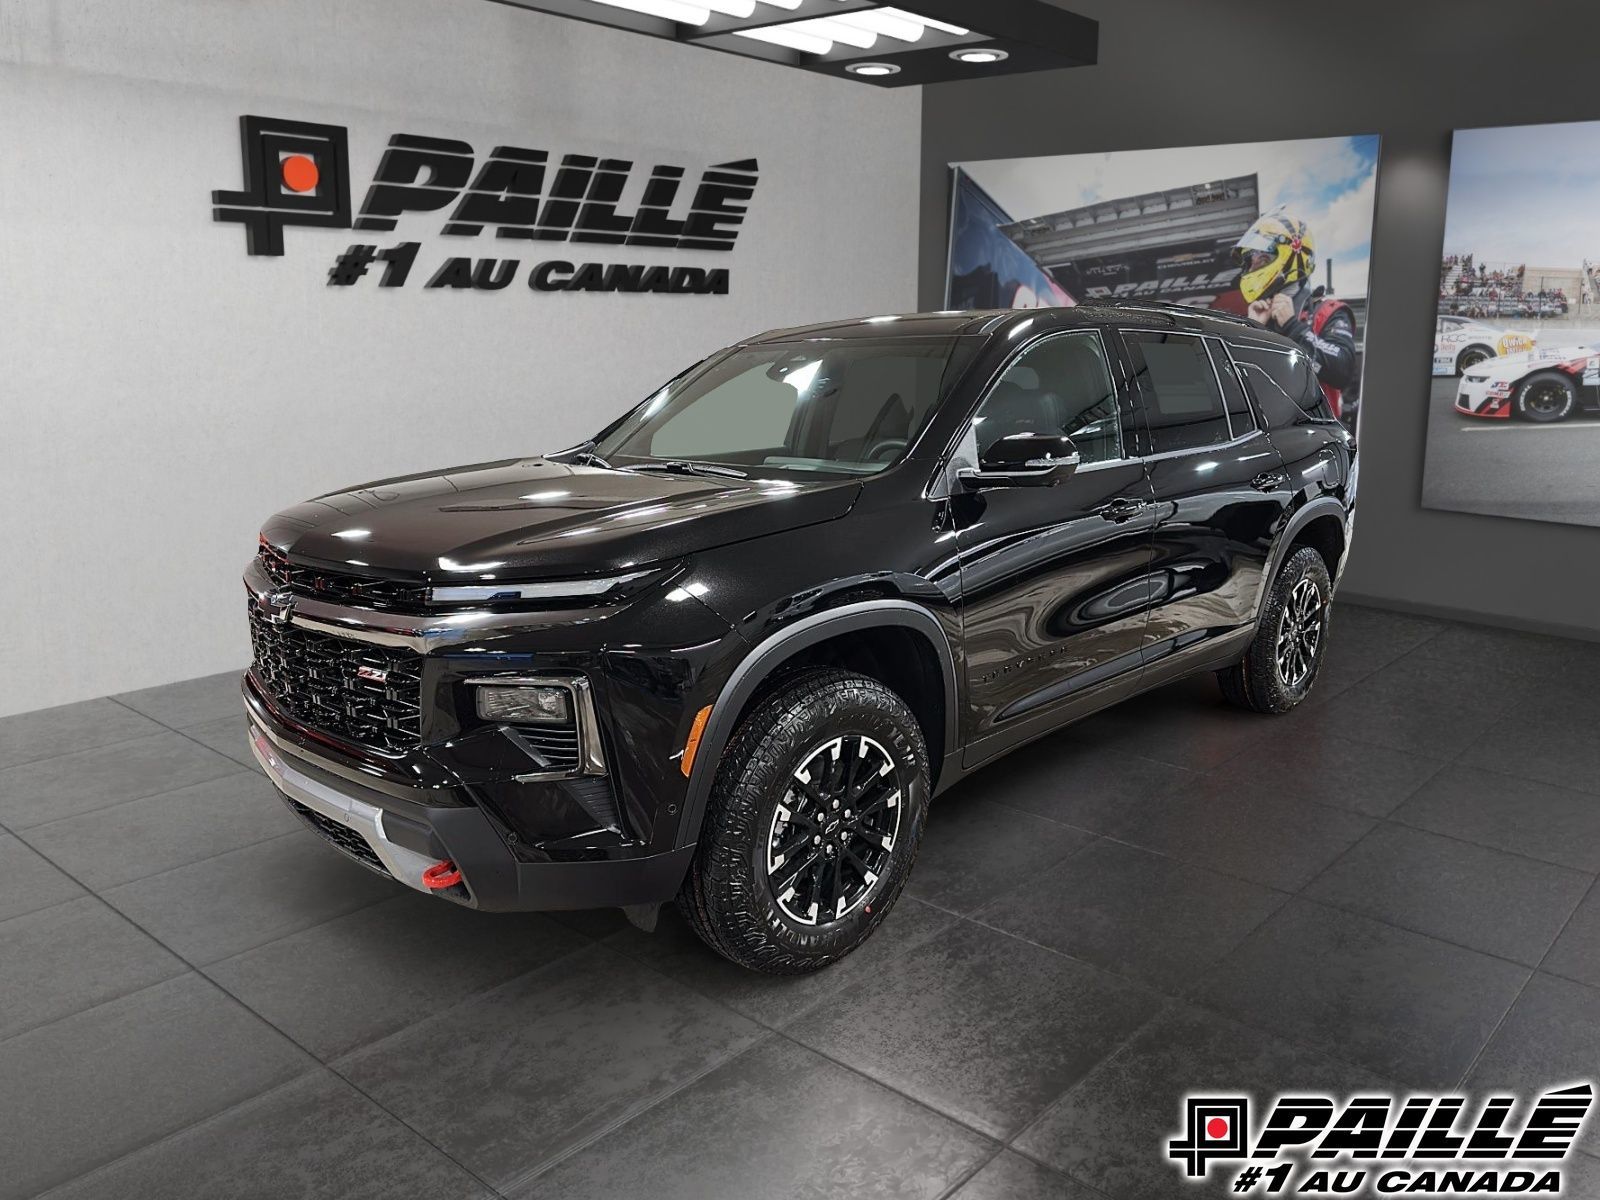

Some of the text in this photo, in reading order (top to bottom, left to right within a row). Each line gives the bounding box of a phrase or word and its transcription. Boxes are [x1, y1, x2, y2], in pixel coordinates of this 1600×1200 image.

[353, 133, 758, 251] PAILLÉ
[327, 242, 729, 295] #1 AU CANADA
